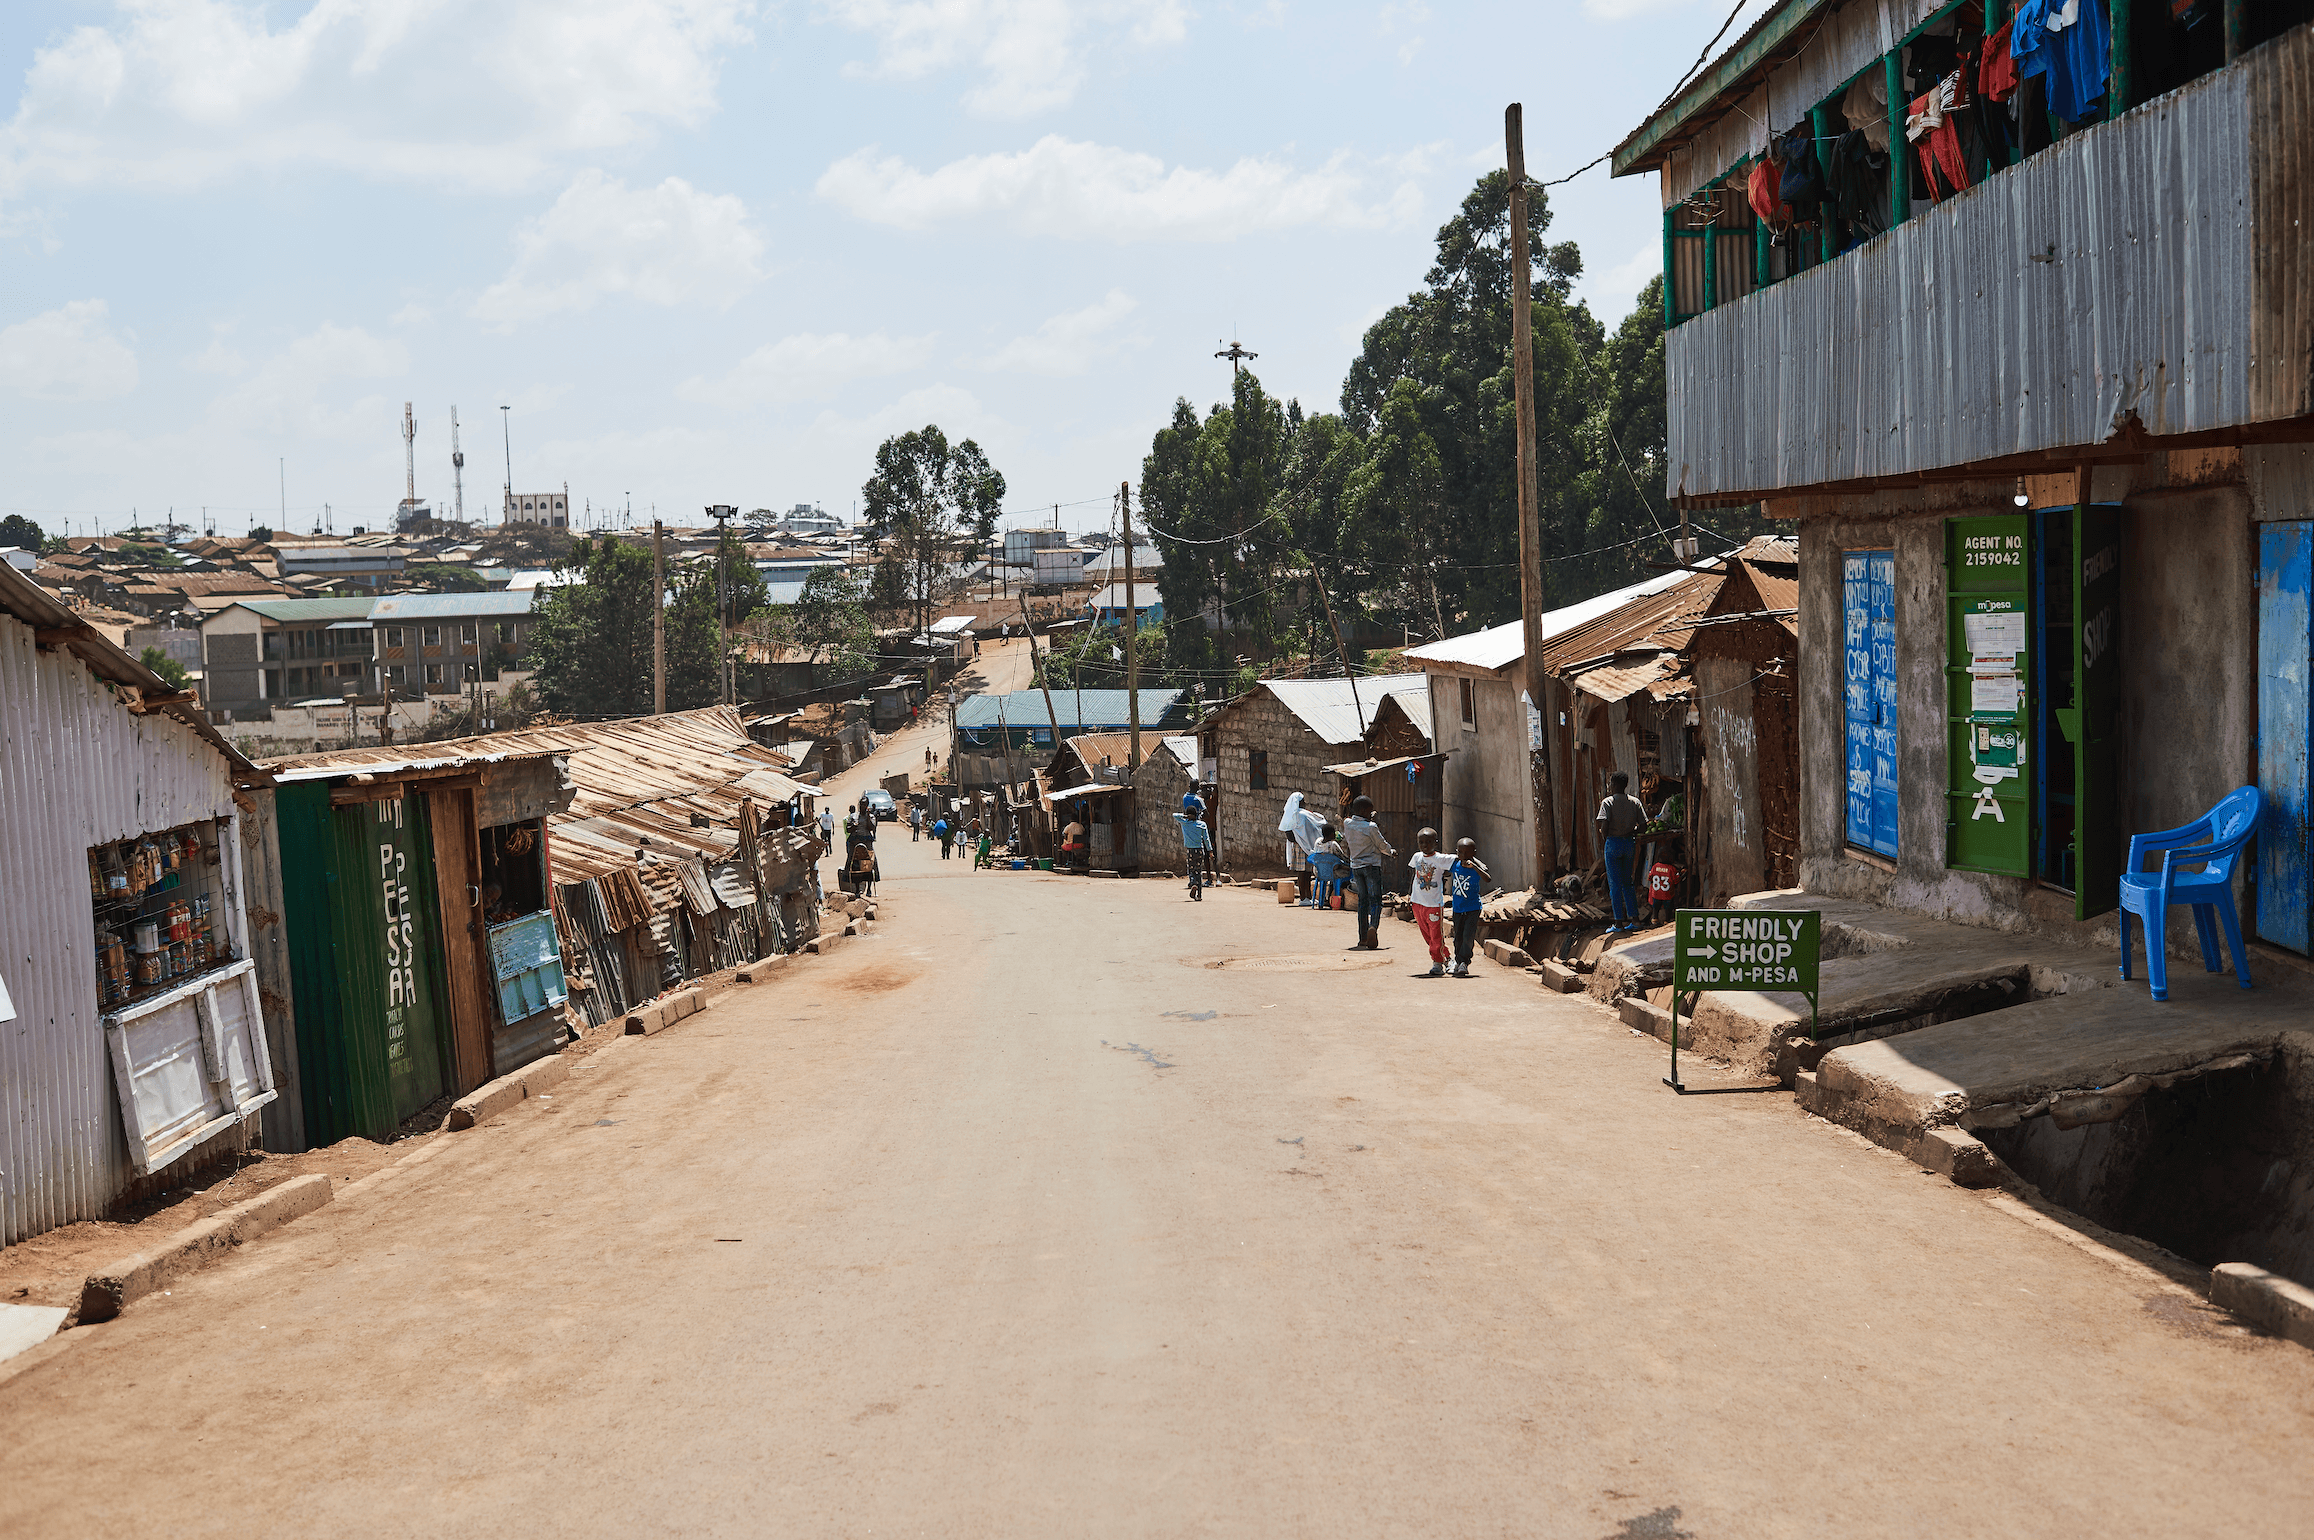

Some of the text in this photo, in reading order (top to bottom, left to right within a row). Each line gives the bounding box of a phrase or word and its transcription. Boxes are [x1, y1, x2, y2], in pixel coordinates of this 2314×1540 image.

[1964, 535, 2023, 549] AGENT NO.
[1965, 551, 2021, 566] 2159042
[2083, 542, 2119, 587] FRIENDLY
[2083, 605, 2111, 669] SHOP
[1652, 875, 1670, 892] 83
[1690, 917, 1804, 941] FRIENDLY
[1721, 942, 1792, 965] SHOP
[1686, 966, 1799, 984] AND M-PESA
